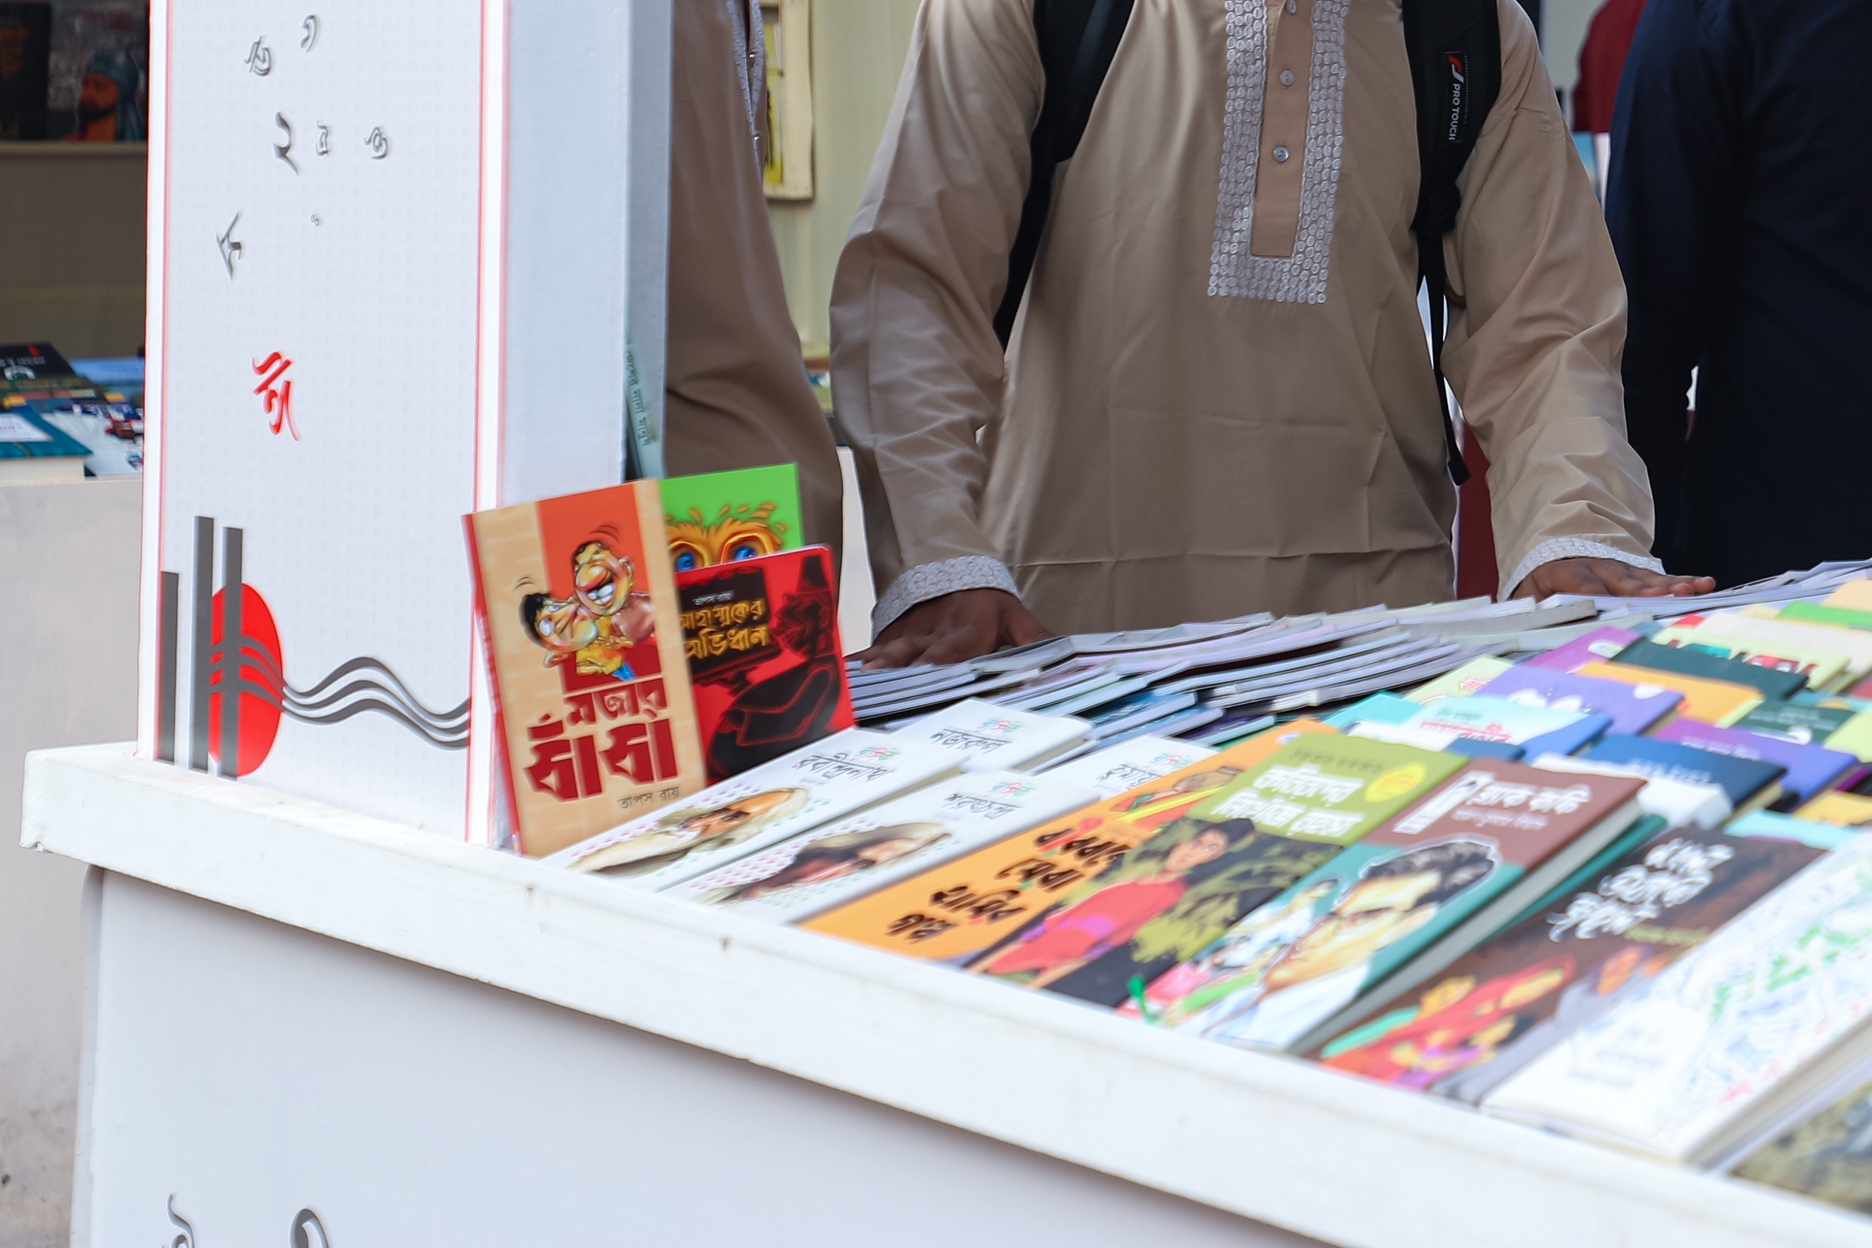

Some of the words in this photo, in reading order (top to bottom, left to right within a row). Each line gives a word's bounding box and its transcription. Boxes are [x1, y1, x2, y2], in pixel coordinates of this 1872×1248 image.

[1452, 83, 1461, 106] PRO
[1448, 106, 1460, 141] TOUCH
[637, 417, 652, 447] মানুষ
[684, 625, 767, 659] অভিধান
[564, 678, 668, 726] মজার
[930, 728, 1013, 755] নজরুল
[524, 714, 679, 802] ধাঁধা
[792, 751, 896, 783] রবীন্দ্রনাথ
[617, 792, 654, 810] তাপস
[660, 786, 680, 802] রায়
